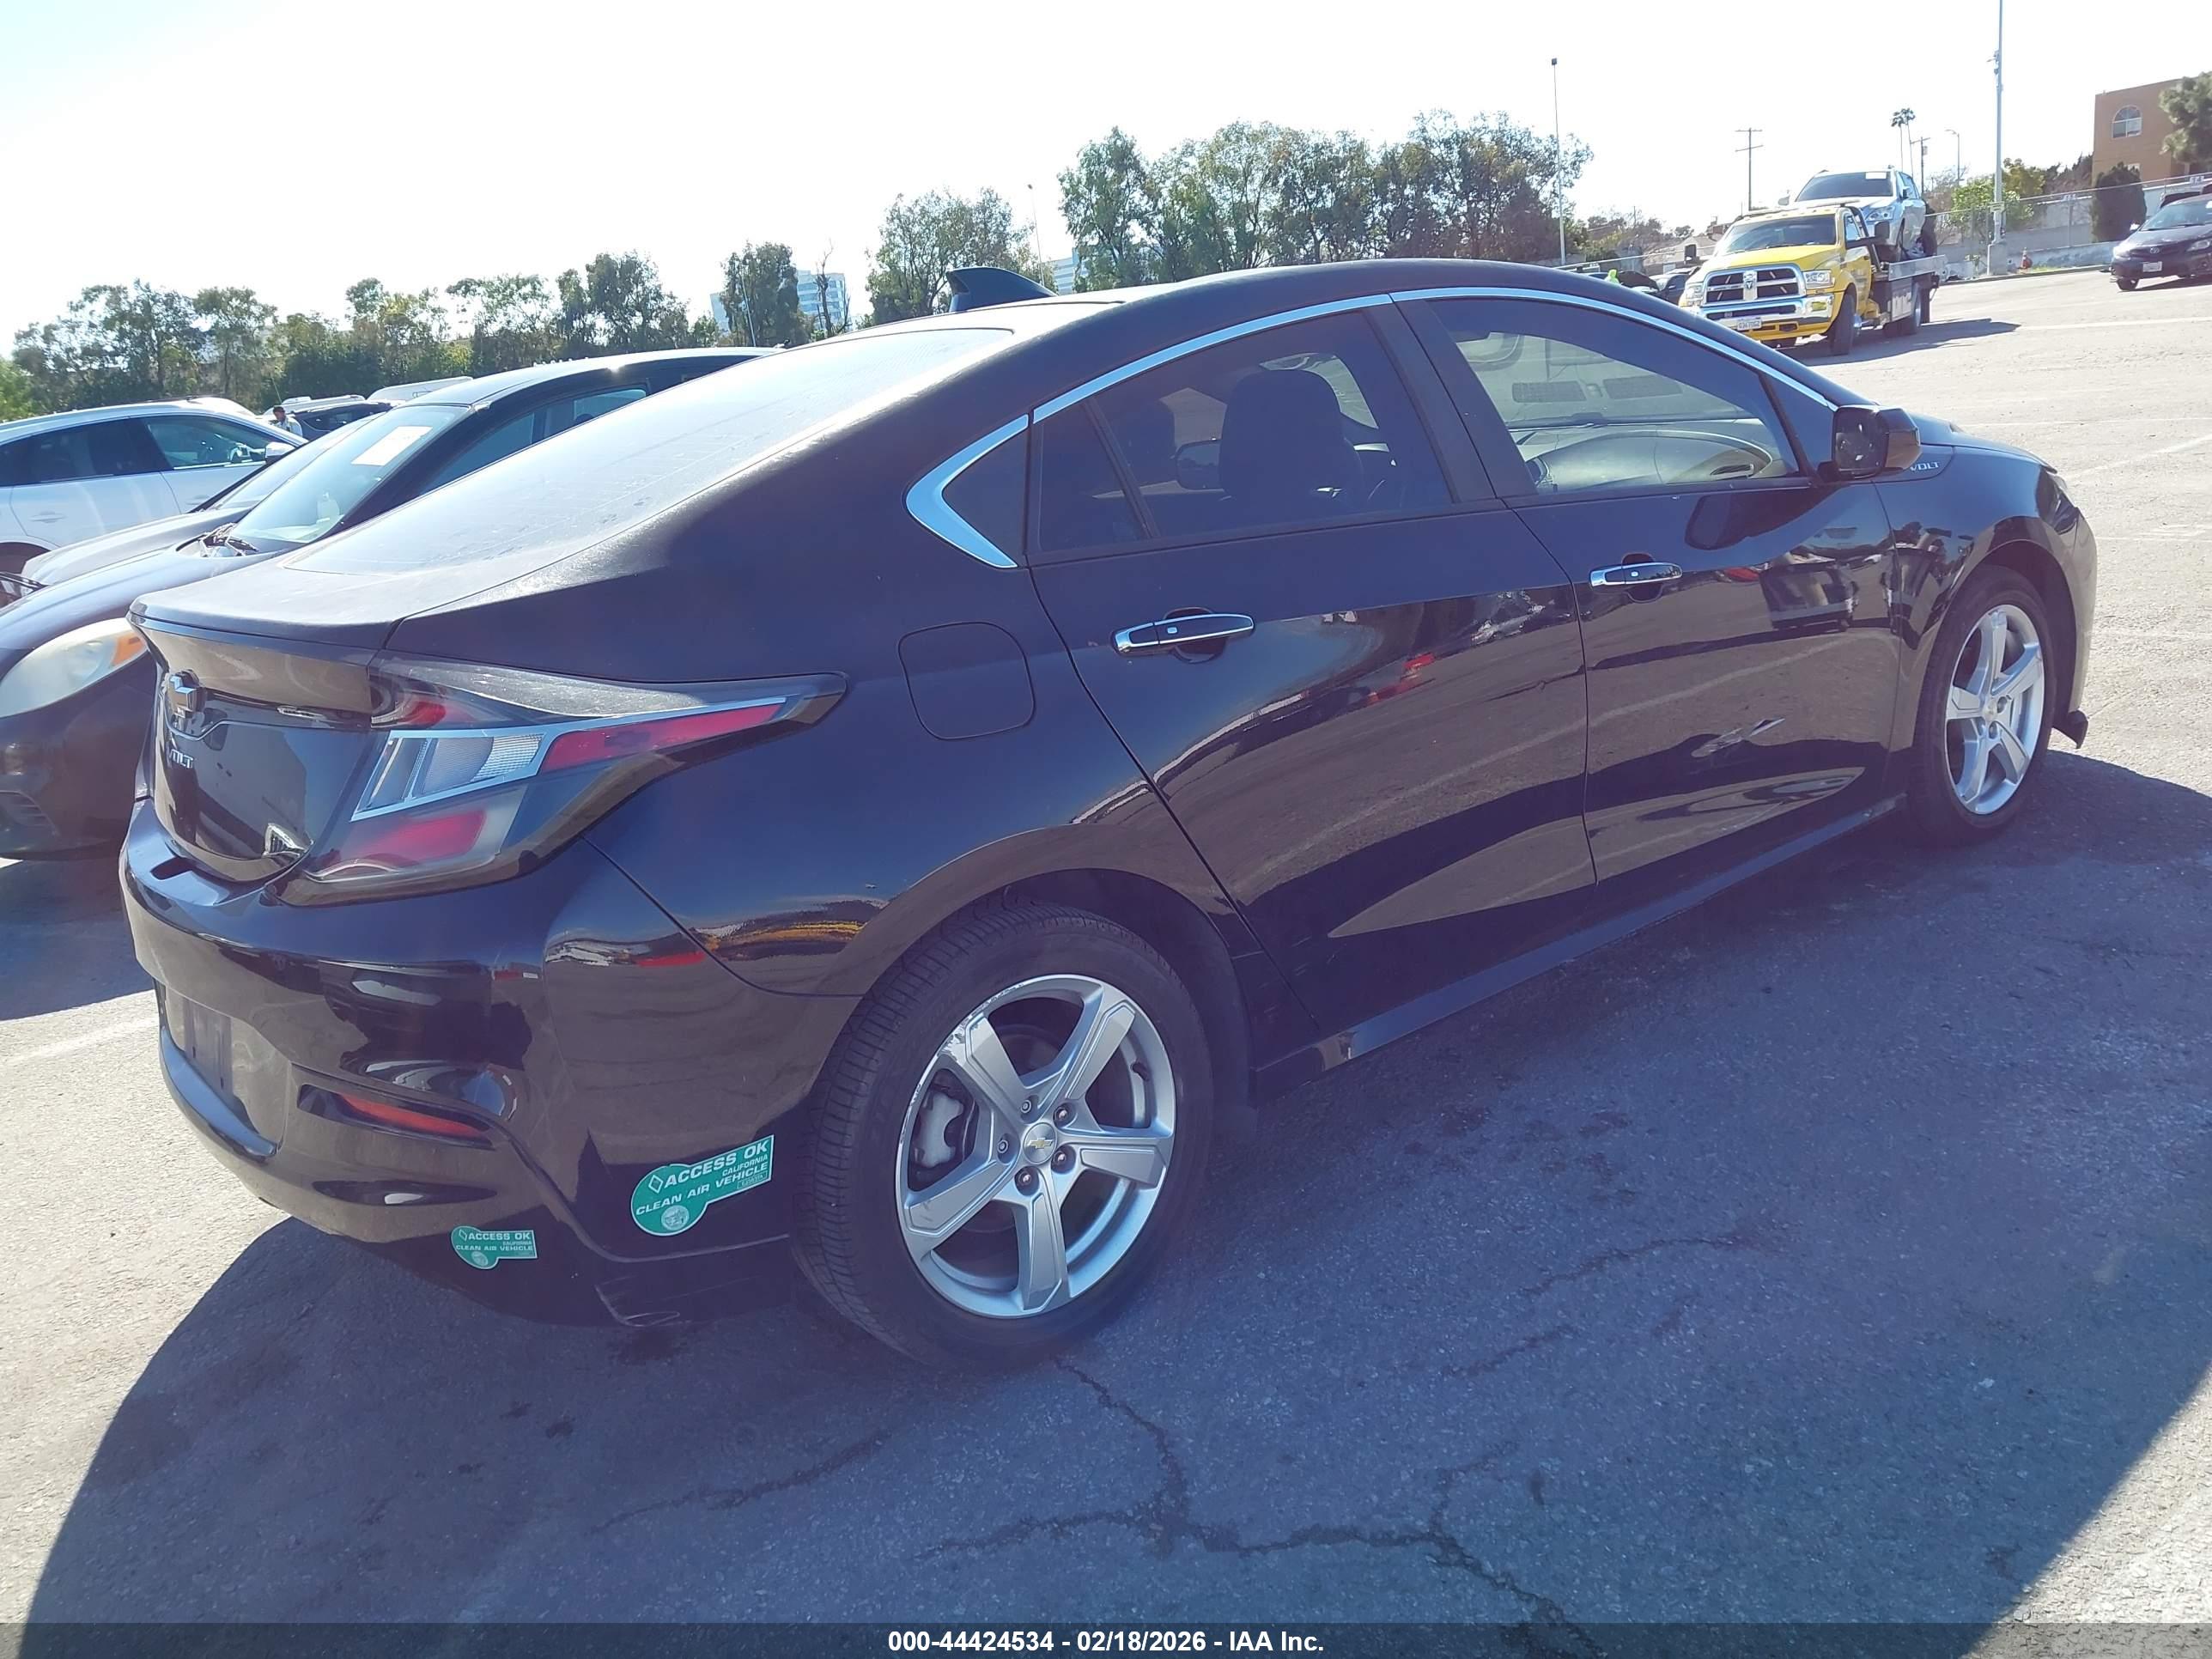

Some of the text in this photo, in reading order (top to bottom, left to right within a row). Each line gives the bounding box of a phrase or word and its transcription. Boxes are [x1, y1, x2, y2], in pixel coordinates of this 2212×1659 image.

[1910, 461, 1939, 471] VOLT
[664, 1152, 737, 1188] ACCESS
[744, 1140, 769, 1159] OK
[722, 1153, 769, 1177] CALIFORNIA
[635, 1193, 683, 1215] CLEAN
[687, 1182, 711, 1199] AIR
[715, 1162, 769, 1188] VEHICLE
[468, 1232, 511, 1241] ACCESS
